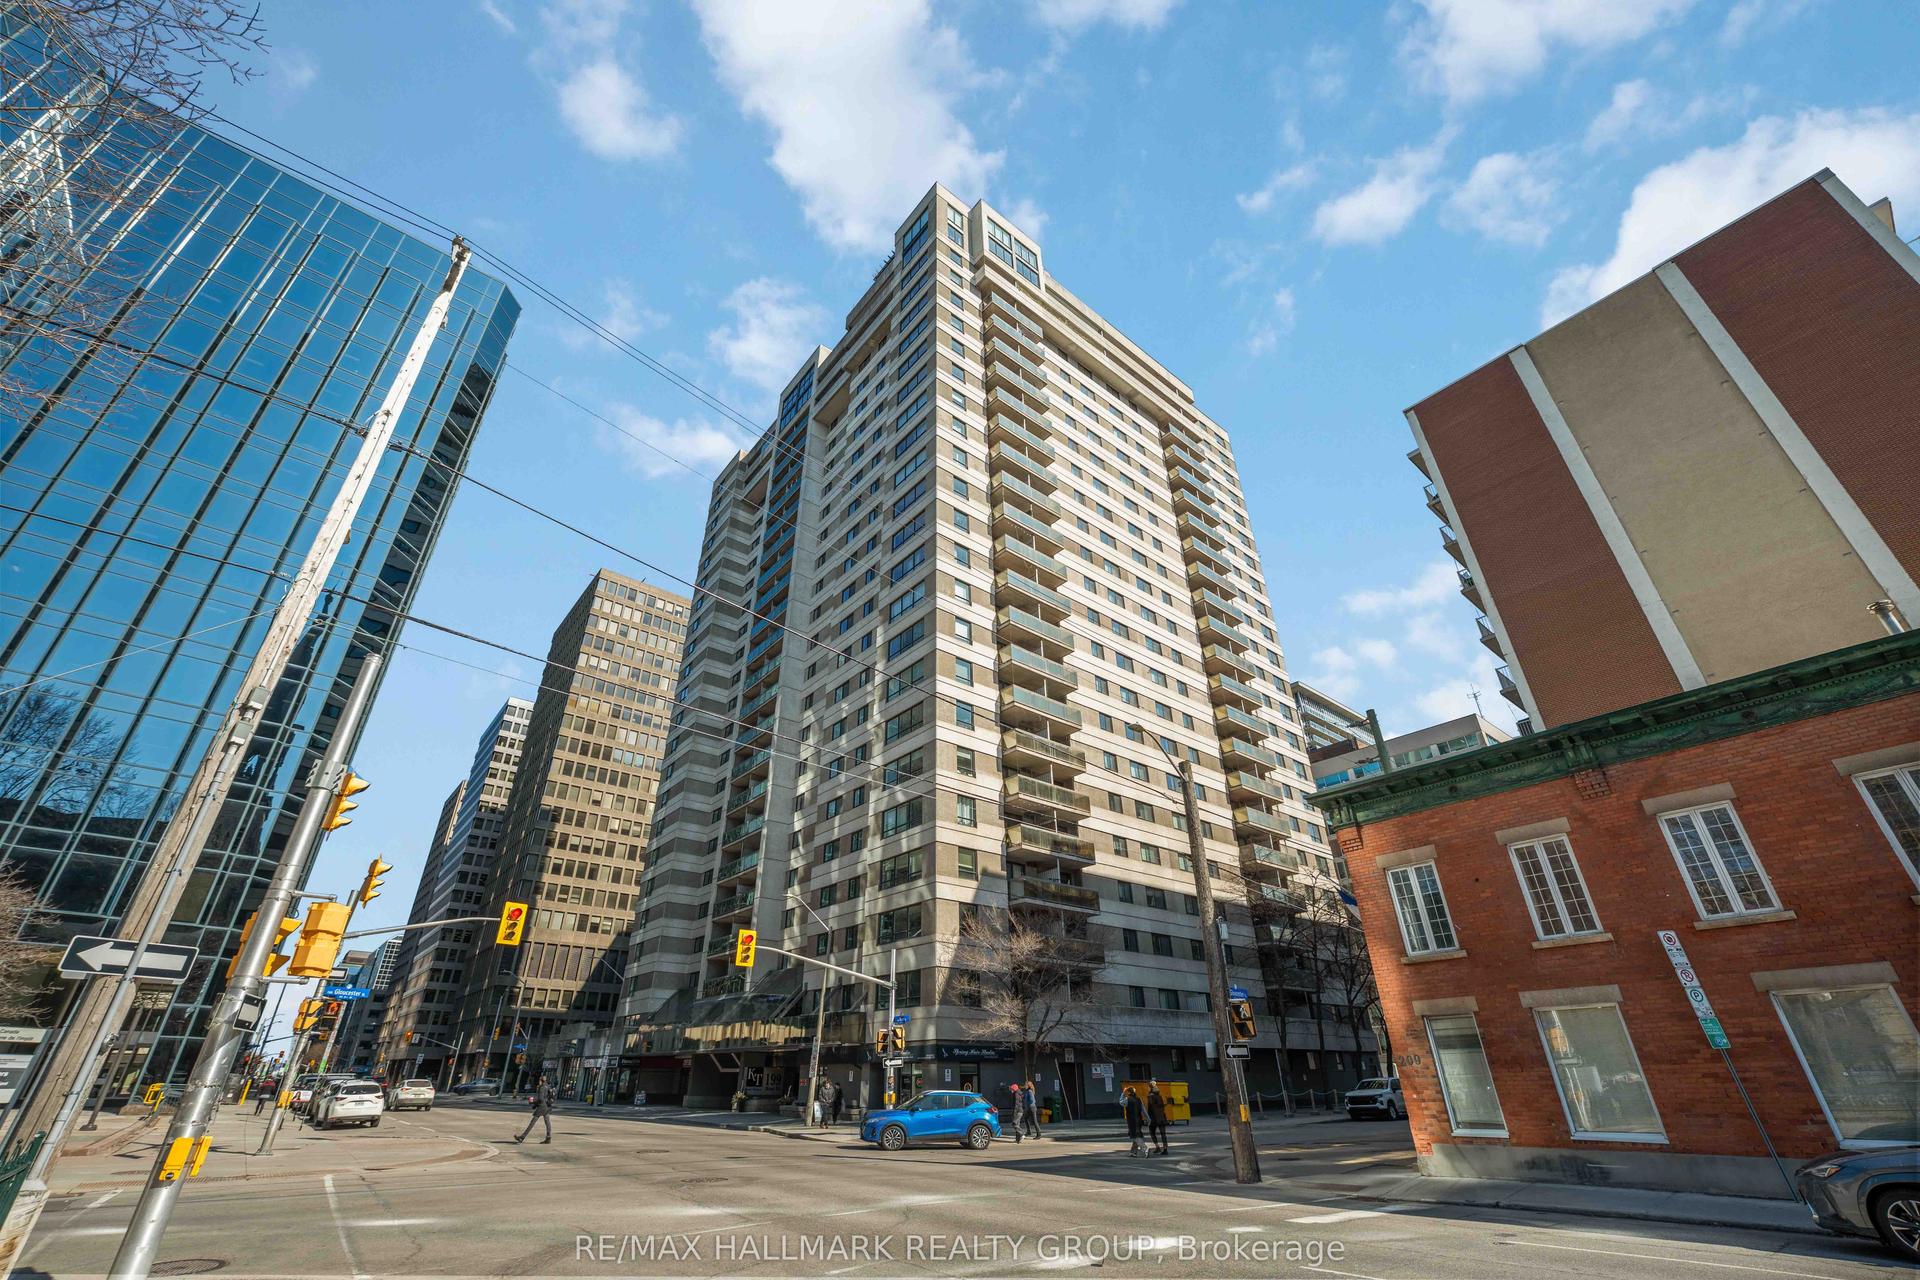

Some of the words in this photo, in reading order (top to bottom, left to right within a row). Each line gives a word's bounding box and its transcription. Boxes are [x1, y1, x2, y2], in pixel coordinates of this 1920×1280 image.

[334, 988, 361, 996] Gloucester
[1398, 1055, 1421, 1066] 209
[747, 1067, 763, 1086] KT
